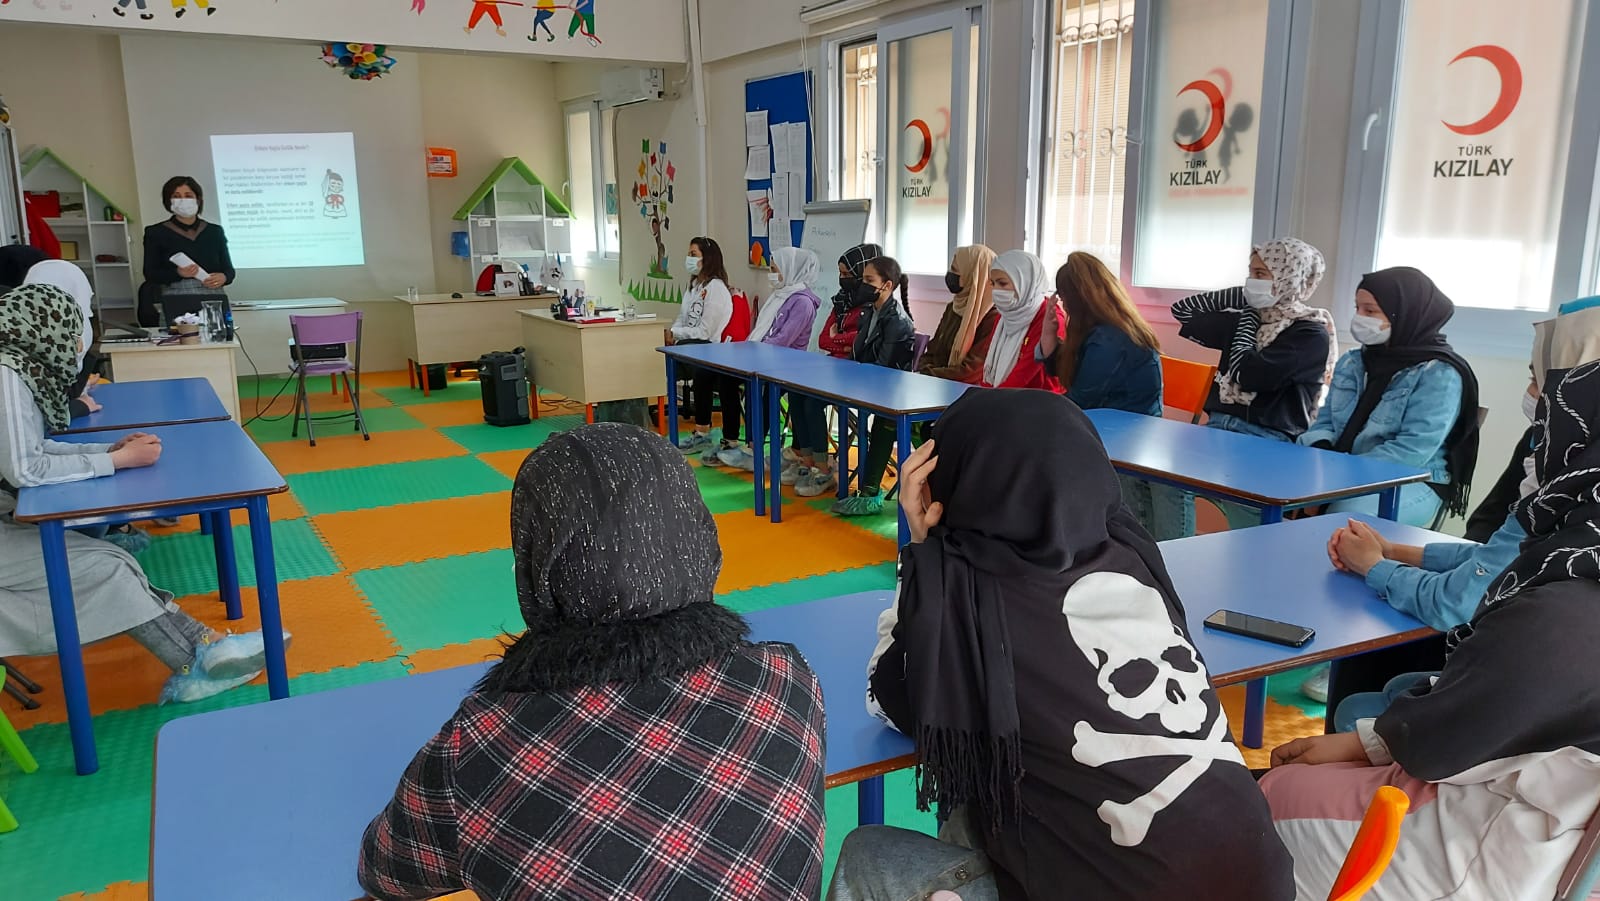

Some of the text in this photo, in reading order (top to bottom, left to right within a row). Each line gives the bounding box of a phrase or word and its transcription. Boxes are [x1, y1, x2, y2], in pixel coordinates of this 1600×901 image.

[1458, 143, 1492, 156] TÜRK
[1185, 158, 1208, 168] TÜRK
[1433, 158, 1514, 177] KIZILAY
[1169, 169, 1221, 186] KIZILAY
[902, 185, 931, 198] KIZILAY
